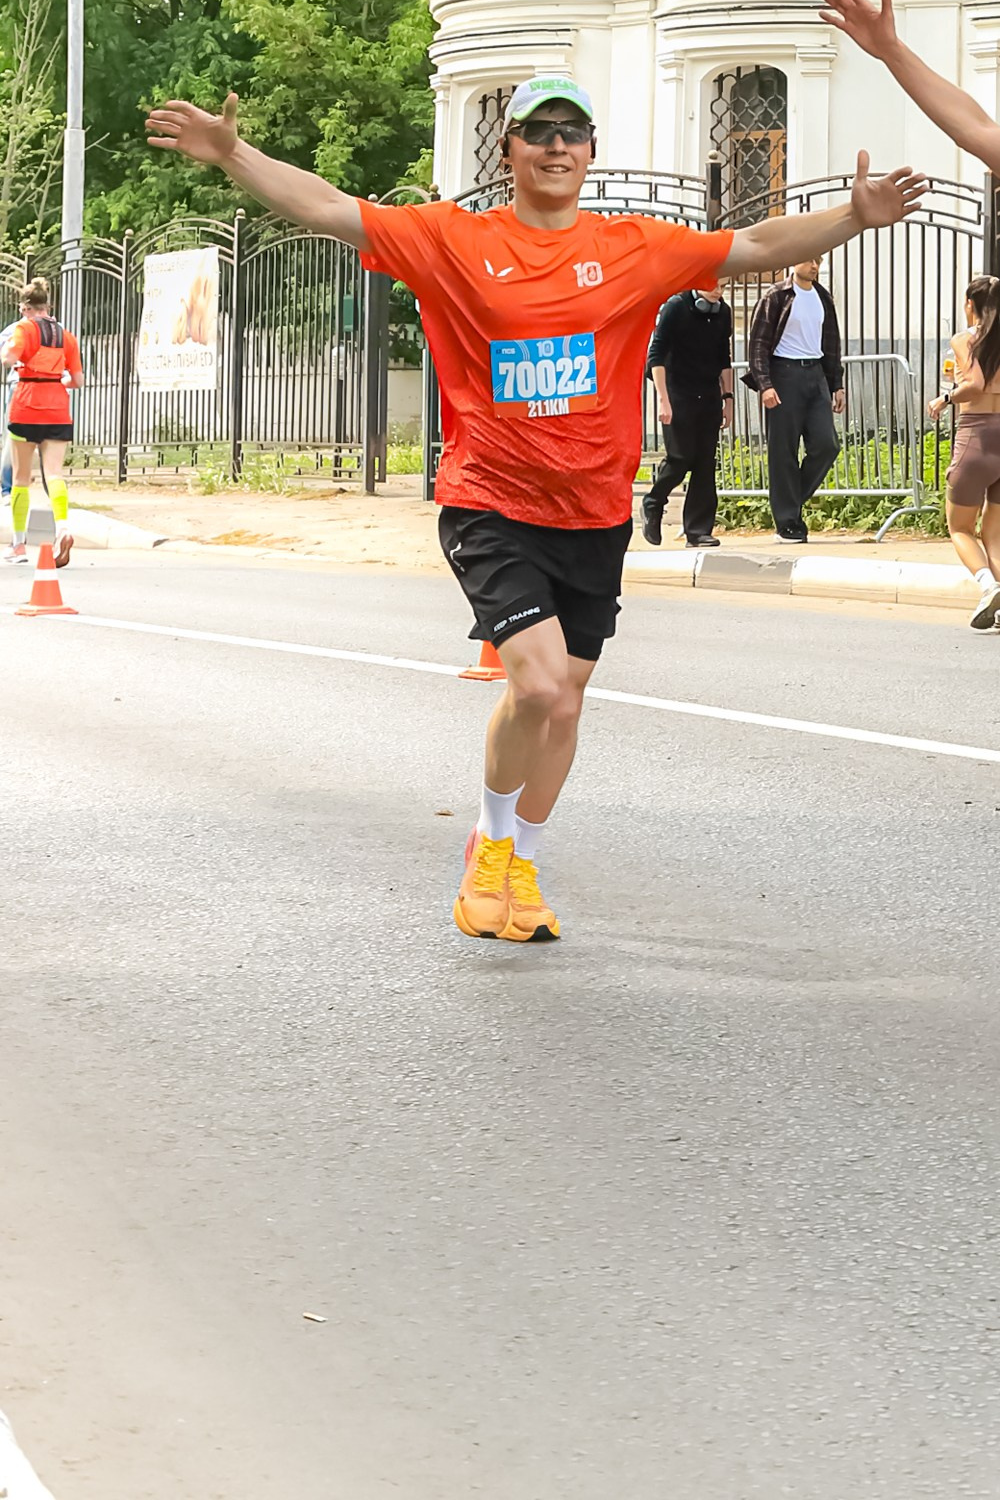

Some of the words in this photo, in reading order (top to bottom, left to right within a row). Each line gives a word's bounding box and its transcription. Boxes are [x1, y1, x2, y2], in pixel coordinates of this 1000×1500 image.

[573, 261, 604, 287] 10
[536, 340, 554, 357] 10
[499, 355, 591, 398] 70022
[527, 398, 570, 418] 21.1KM
[508, 606, 540, 622] TRAINING
